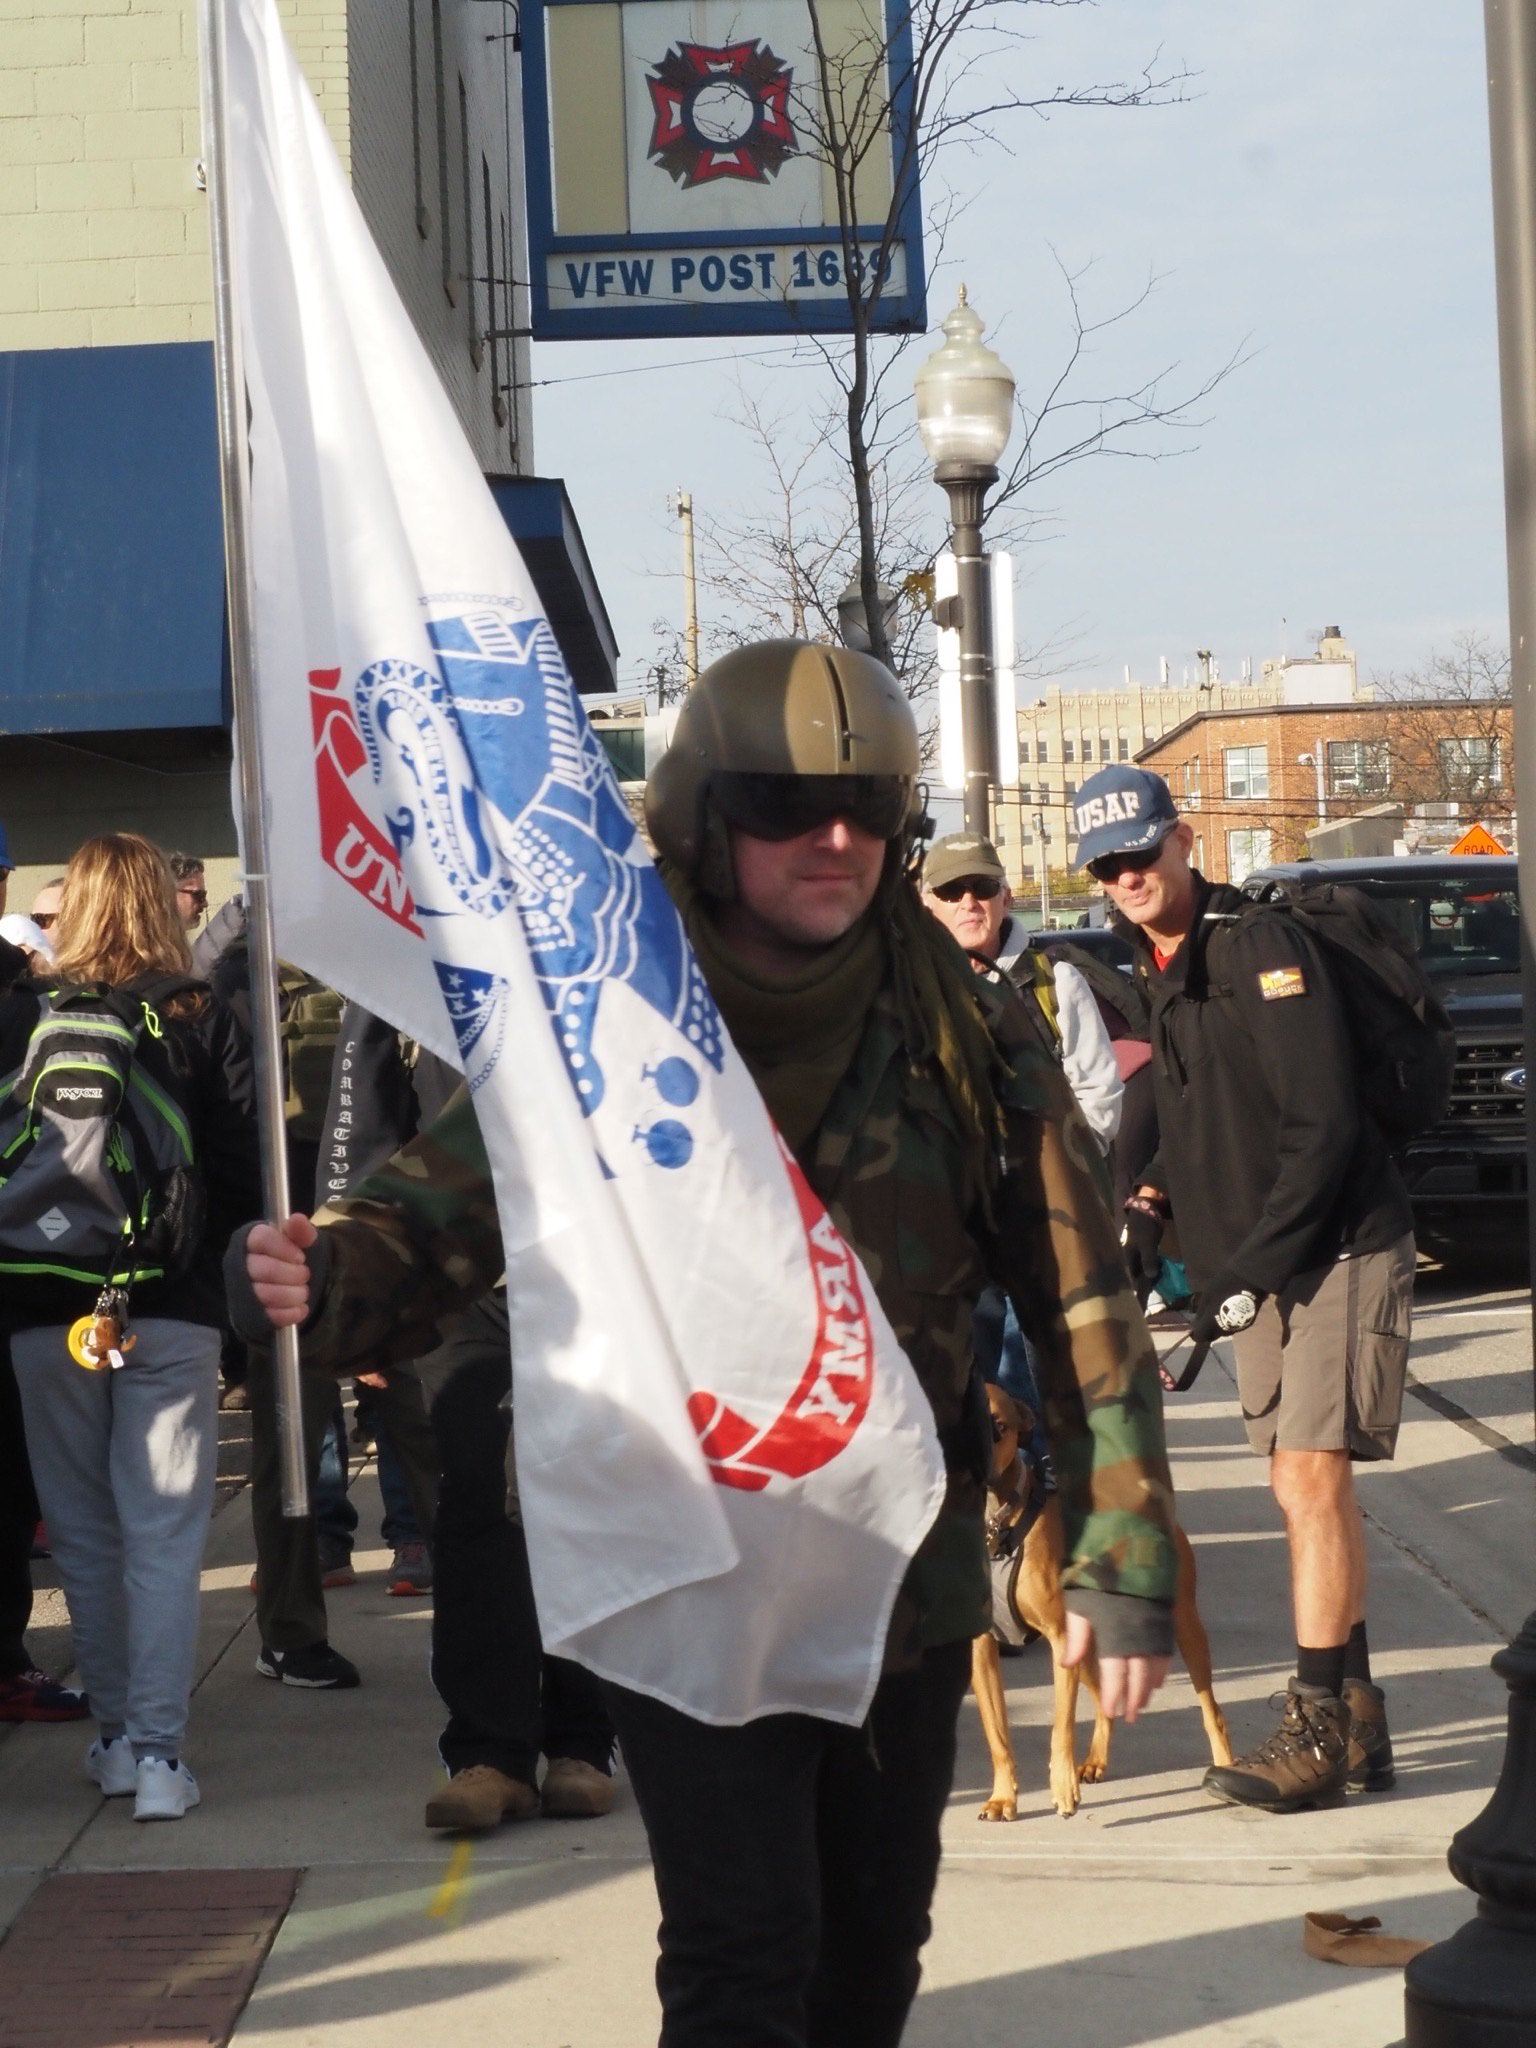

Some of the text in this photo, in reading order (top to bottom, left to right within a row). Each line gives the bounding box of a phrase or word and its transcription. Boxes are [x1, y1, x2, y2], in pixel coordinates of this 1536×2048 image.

[565, 260, 653, 298] VFW
[672, 253, 775, 294] POST
[1076, 791, 1140, 835] USAF
[334, 821, 415, 920] UN
[1463, 845, 1494, 855] ROAD
[795, 1212, 868, 1426] ARMY
